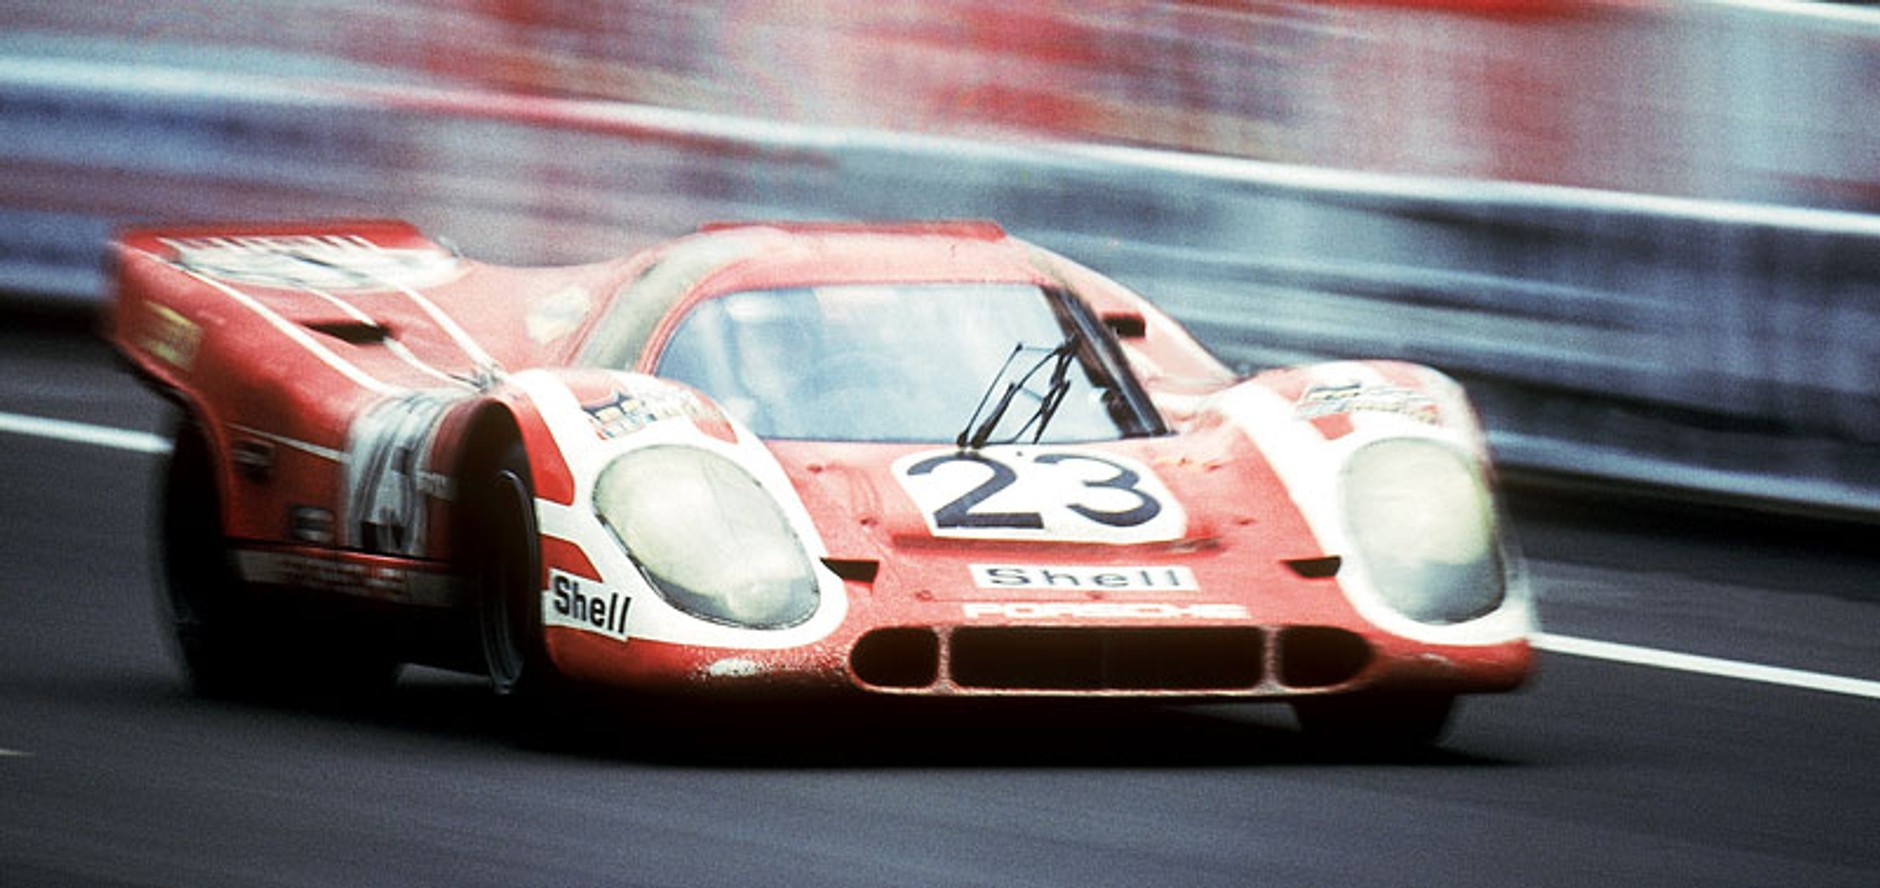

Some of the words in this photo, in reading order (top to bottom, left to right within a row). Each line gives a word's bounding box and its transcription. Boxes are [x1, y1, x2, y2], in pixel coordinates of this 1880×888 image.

[907, 454, 1161, 530] 23
[552, 575, 631, 636] Shell
[985, 567, 1181, 588] Shell
